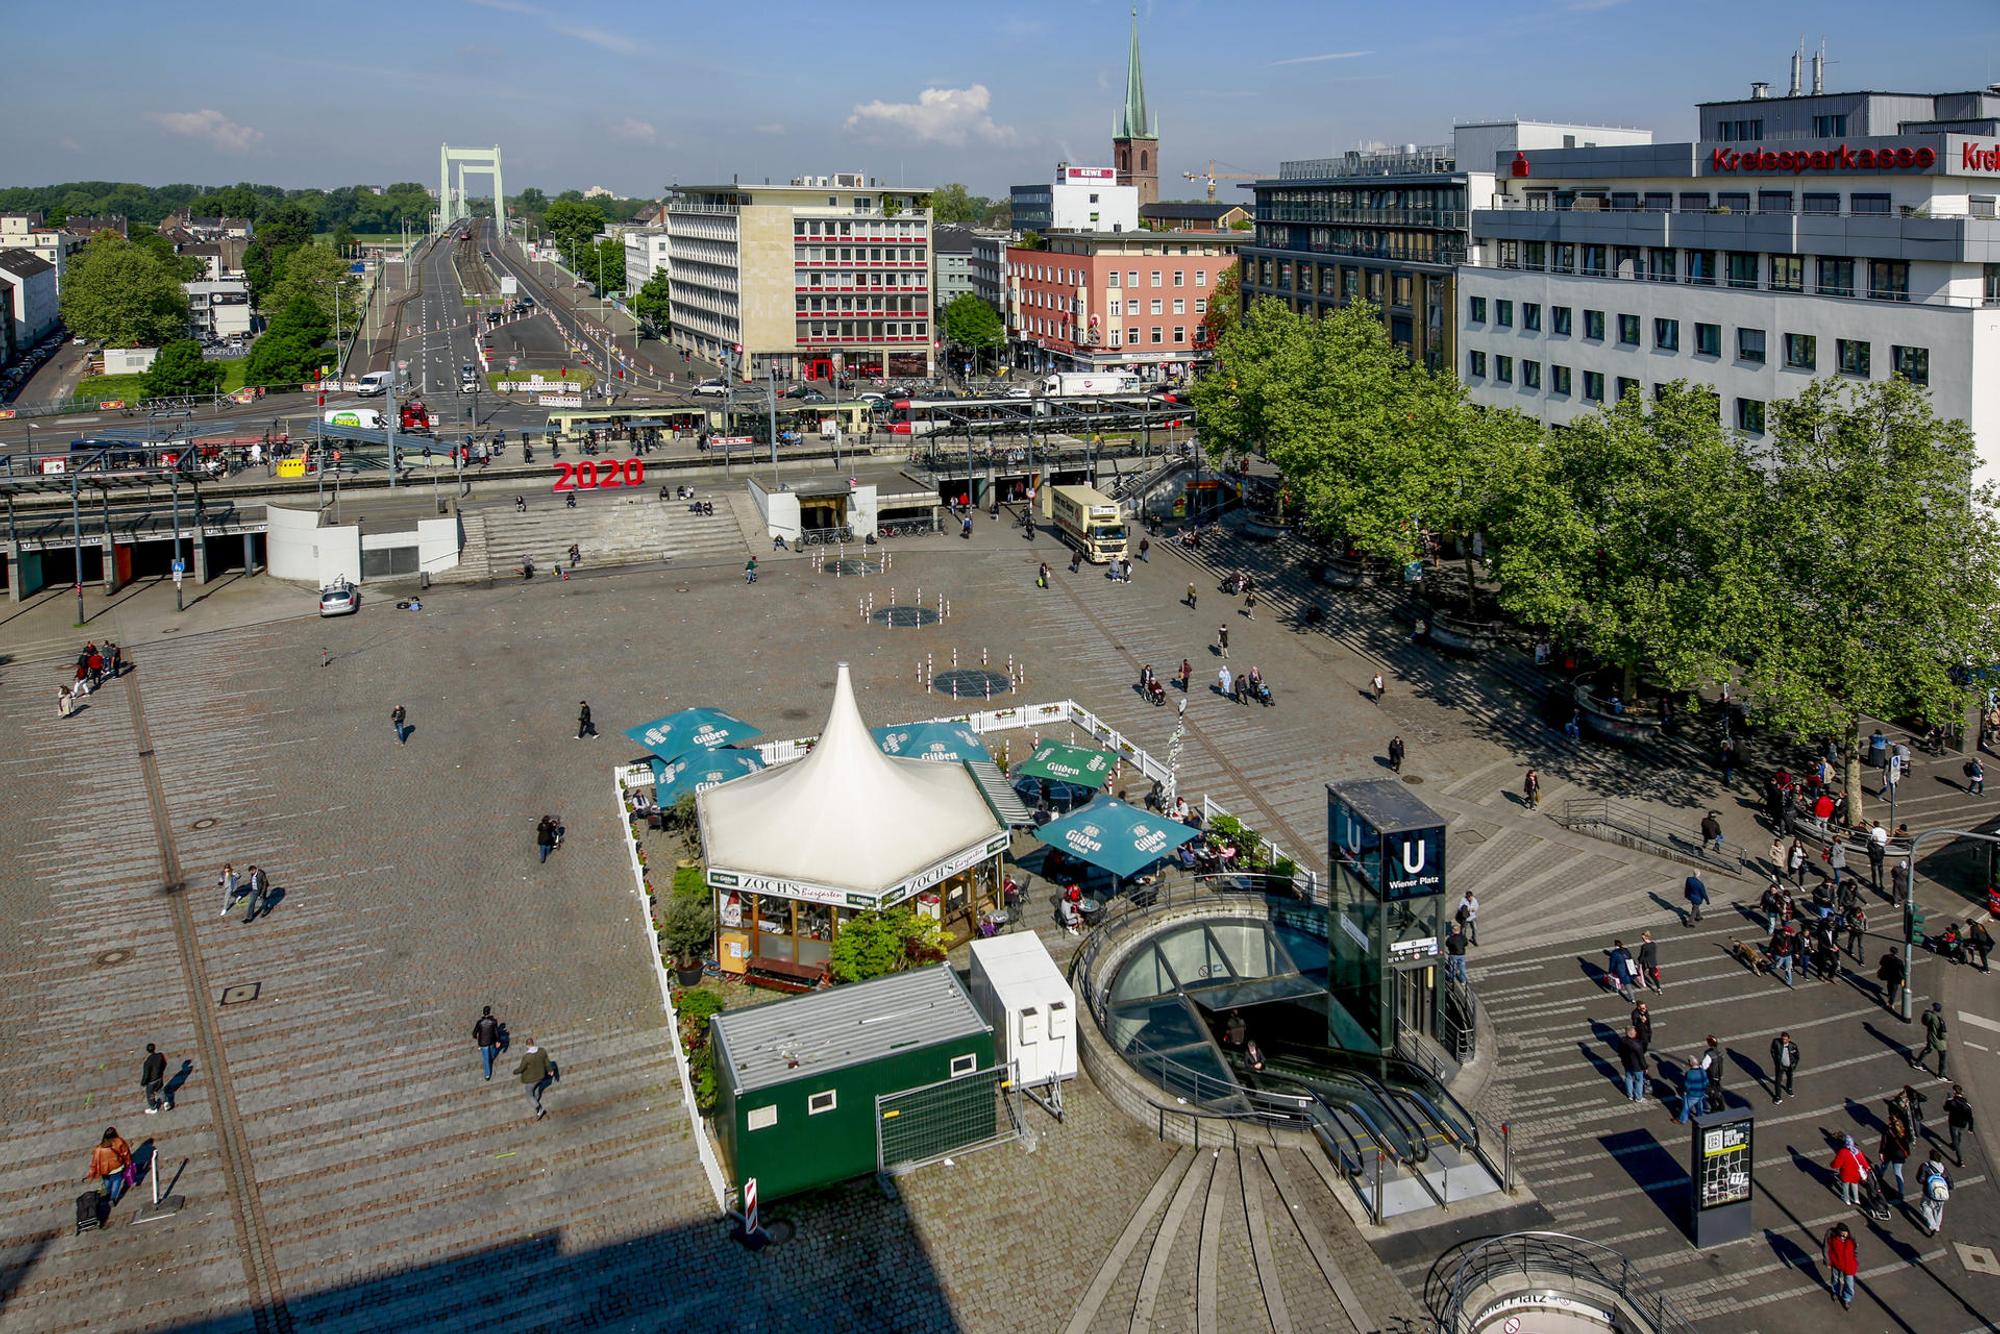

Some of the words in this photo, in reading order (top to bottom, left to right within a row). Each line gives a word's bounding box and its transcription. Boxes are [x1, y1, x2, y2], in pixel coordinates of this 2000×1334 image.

[1713, 143, 1936, 174] Kreissparkasse
[1081, 168, 1102, 177] REWE
[552, 457, 645, 490] 2020
[692, 729, 729, 745] Gilden
[921, 751, 958, 761] Gilden
[1046, 761, 1080, 776] Gilden
[1065, 829, 1102, 852] Gilden
[1134, 829, 1167, 852] Gilden
[1403, 839, 1426, 874] U
[743, 878, 800, 896] ZOCH'S
[801, 887, 843, 901] Biergarten
[909, 864, 954, 892] ZOCH'S
[1389, 879, 1418, 890] Wiener
[1419, 876, 1440, 885] Platz
